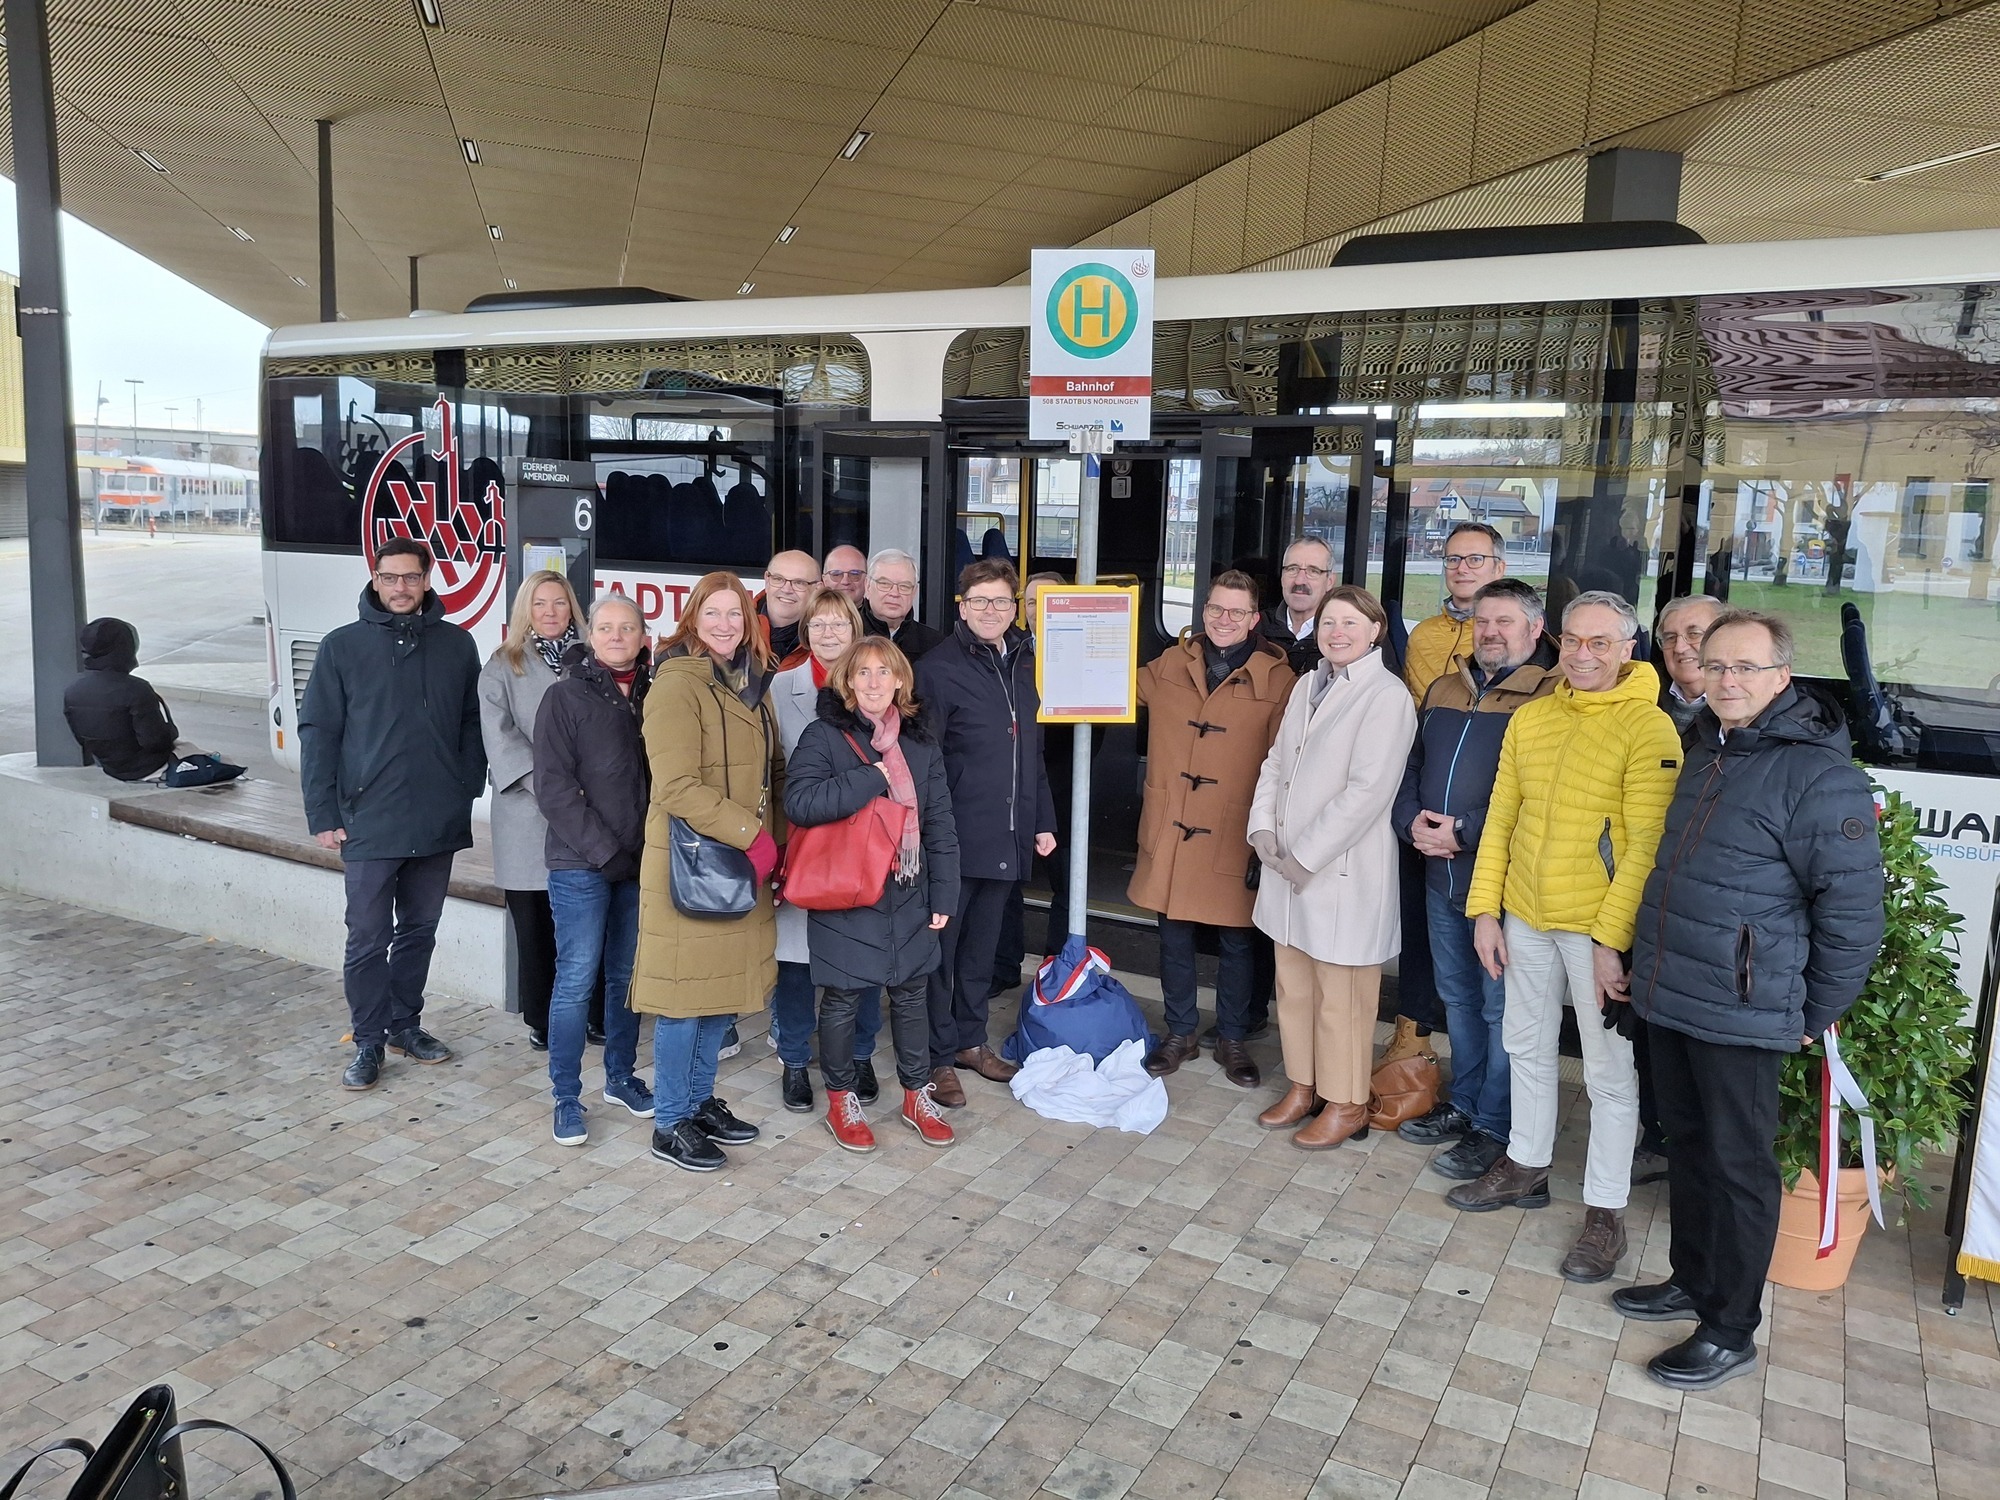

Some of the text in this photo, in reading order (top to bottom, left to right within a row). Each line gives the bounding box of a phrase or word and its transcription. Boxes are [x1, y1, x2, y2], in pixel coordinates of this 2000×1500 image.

[1073, 284, 1111, 338] H
[1066, 381, 1115, 392] Bahnhof
[1093, 396, 1139, 405] NÖRDLINGEN
[522, 462, 557, 472] EDERHEIM
[523, 472, 570, 482] AMERDINGEN
[574, 498, 592, 531] 6
[1917, 841, 2000, 862] HRSBÜ
